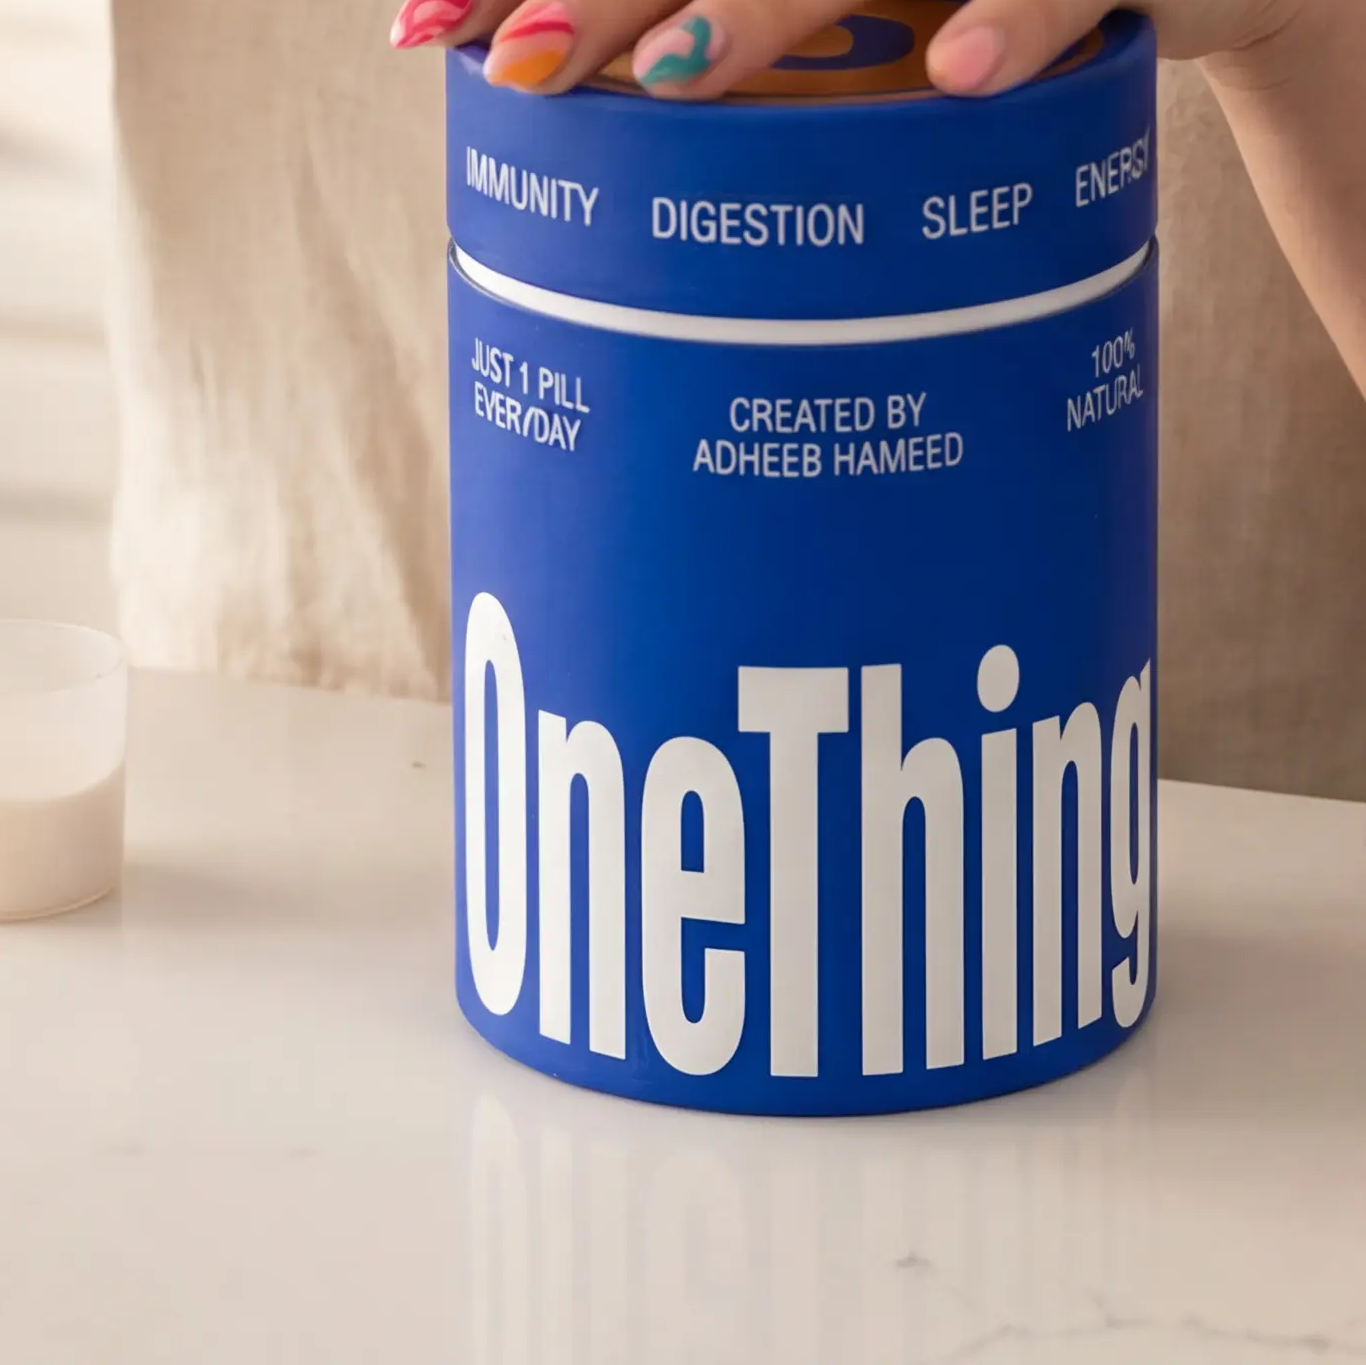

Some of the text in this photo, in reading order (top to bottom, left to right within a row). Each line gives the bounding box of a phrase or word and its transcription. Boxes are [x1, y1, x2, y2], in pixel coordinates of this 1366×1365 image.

[466, 146, 599, 227] IMMUNITY
[652, 196, 865, 248] DIGESTION
[922, 182, 1033, 240] SLEEP
[471, 337, 591, 414] JUST 1 PILL
[1091, 327, 1136, 379] 100%
[729, 391, 927, 434] CREATED BY
[1066, 363, 1144, 432] NATURAL
[692, 431, 964, 478] ADHEEB HAMEED
[464, 591, 1150, 1078] OneThing
